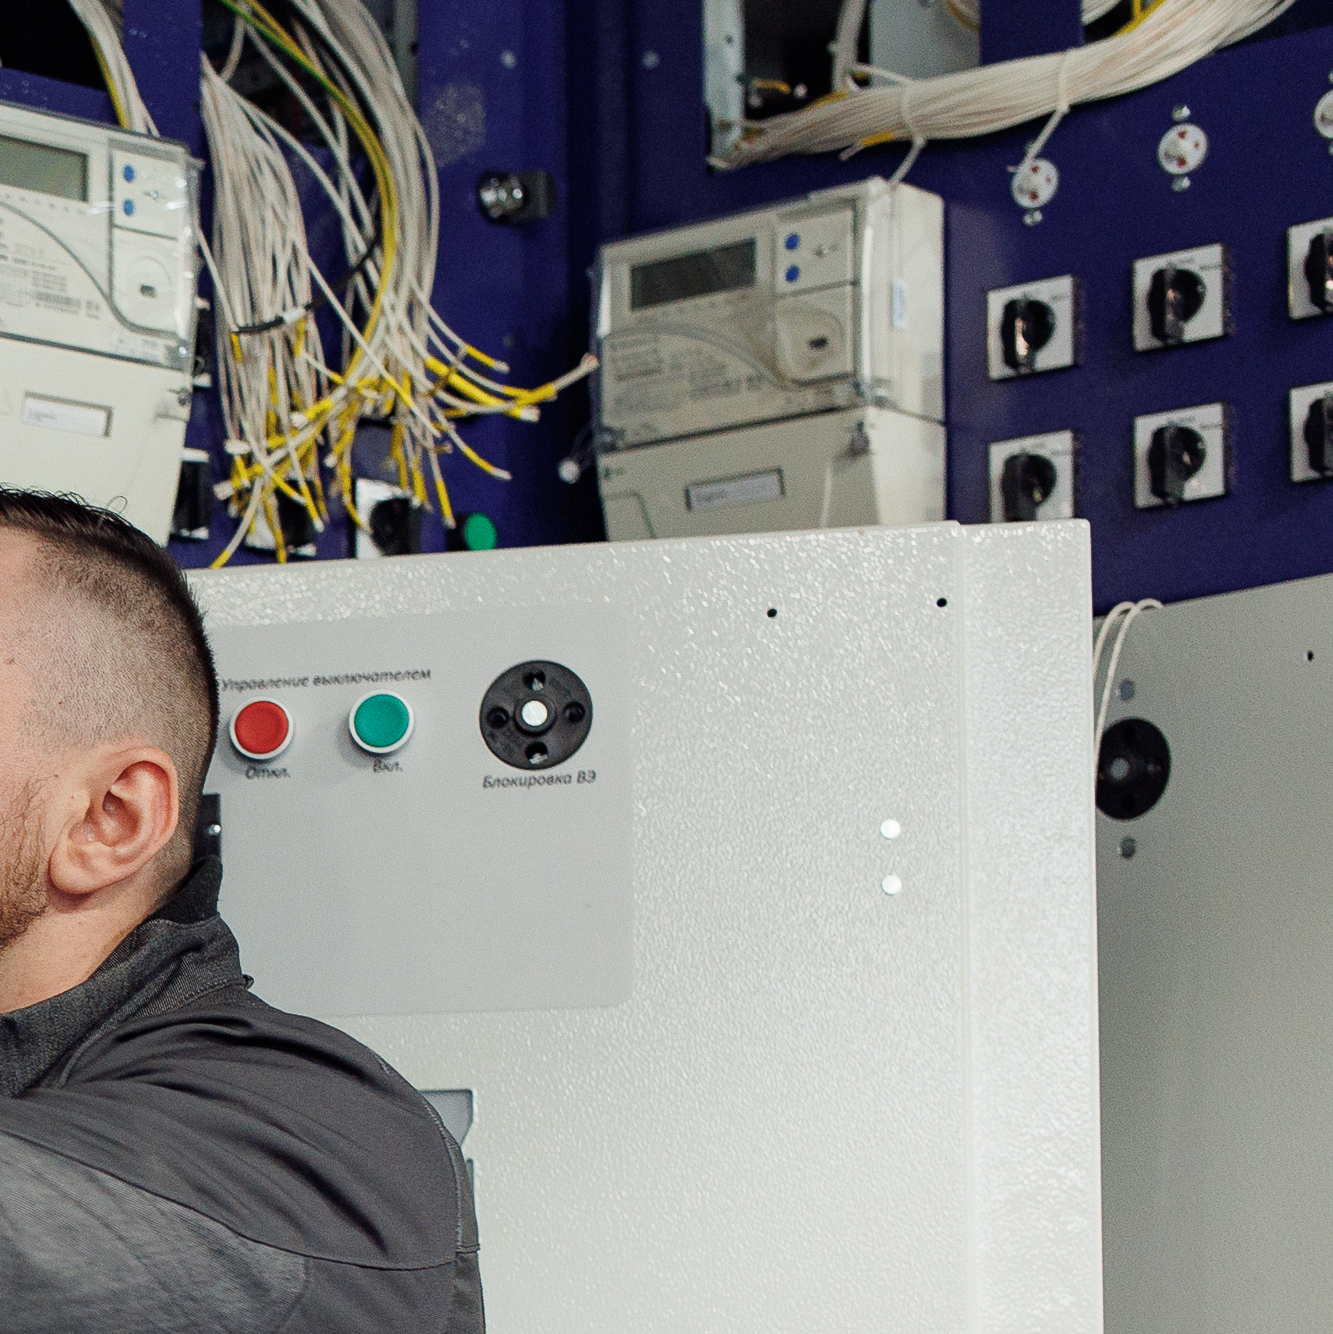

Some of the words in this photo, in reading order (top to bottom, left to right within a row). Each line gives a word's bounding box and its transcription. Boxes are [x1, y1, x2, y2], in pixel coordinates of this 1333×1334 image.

[221, 676, 310, 693] Управление
[312, 669, 432, 687] выключателем
[482, 774, 573, 790] Блокировка
[576, 769, 597, 784] ВЭ
